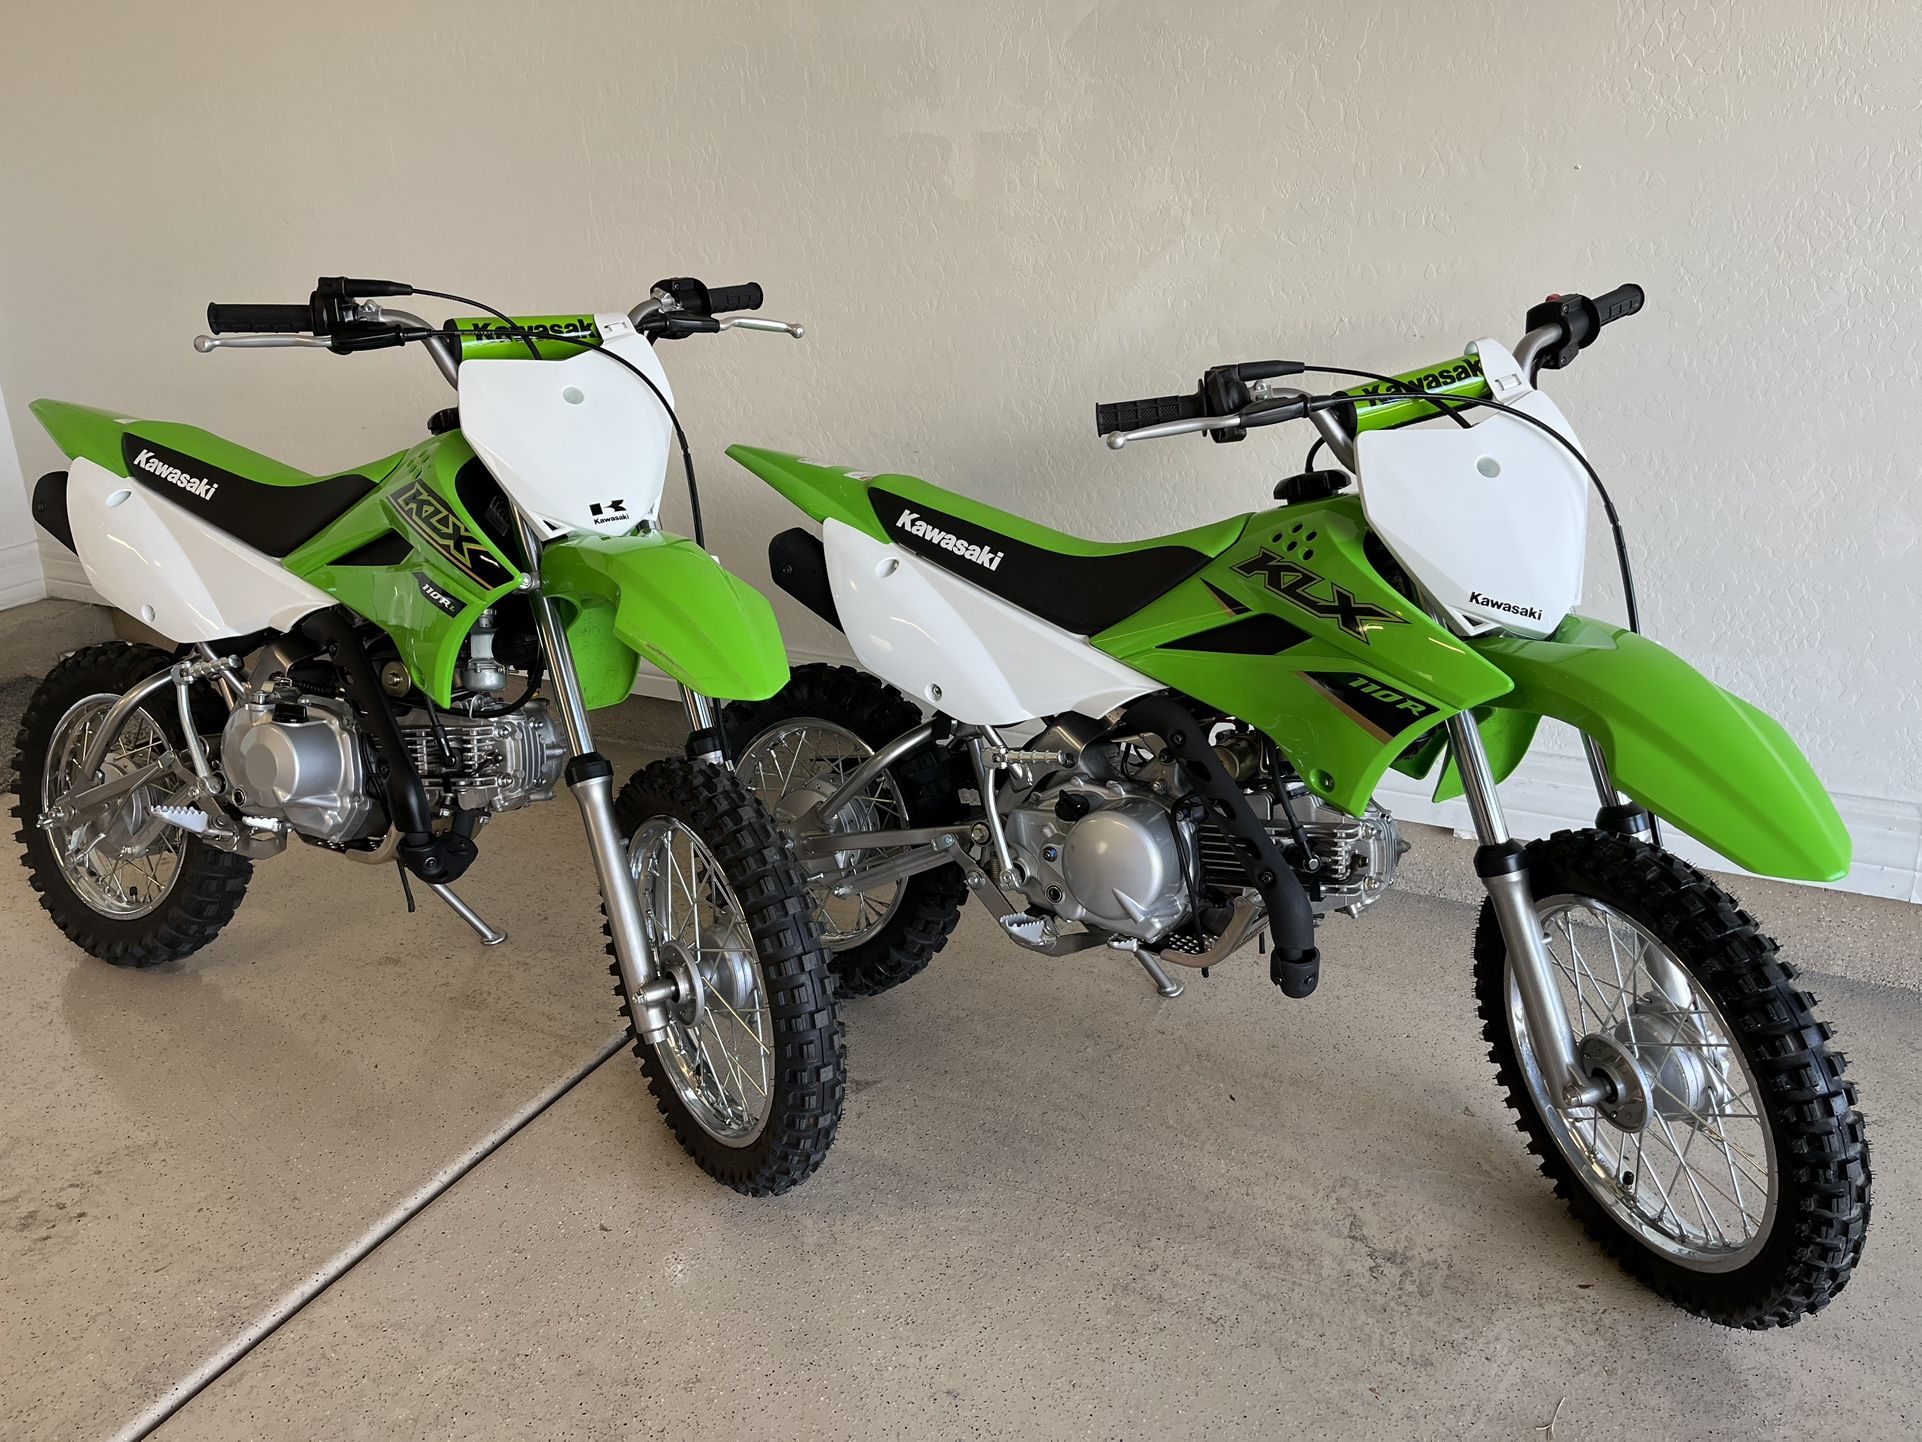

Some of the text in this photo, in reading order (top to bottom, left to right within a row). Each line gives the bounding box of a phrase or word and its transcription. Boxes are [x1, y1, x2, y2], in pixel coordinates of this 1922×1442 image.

[472, 319, 597, 342] Kawasak
[1361, 359, 1484, 406] Kawasak
[133, 449, 218, 500] Kawasaki
[397, 482, 489, 568] KLX
[594, 513, 629, 525] Kawasaki
[896, 509, 1004, 571] Kawasaki
[1229, 547, 1412, 645] KLX
[1469, 591, 1542, 621] Kawasaki
[1349, 677, 1426, 717] 110R
